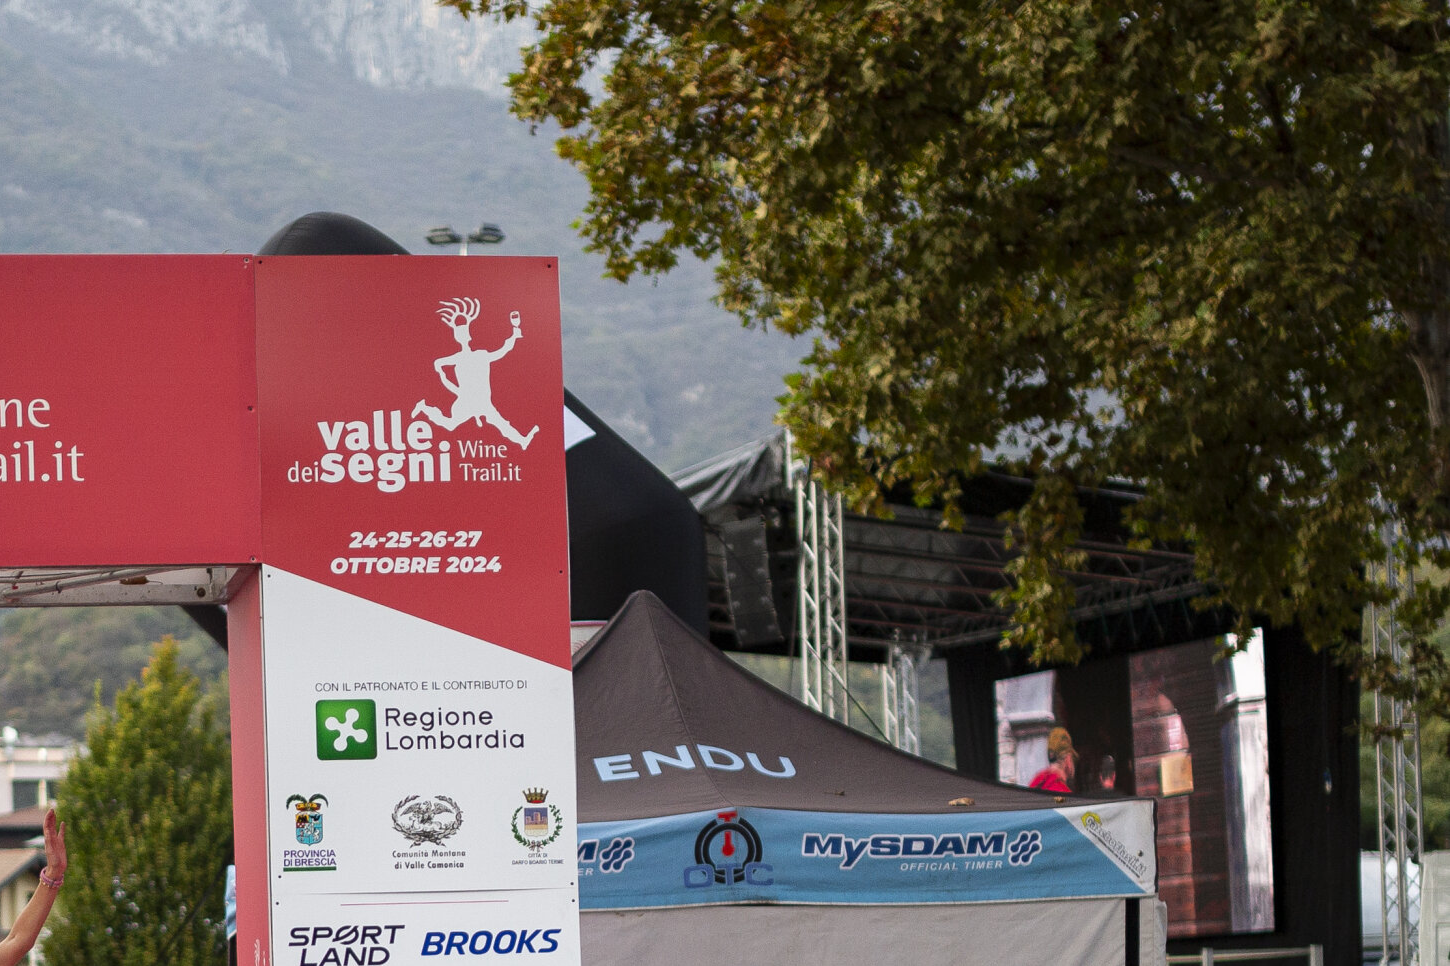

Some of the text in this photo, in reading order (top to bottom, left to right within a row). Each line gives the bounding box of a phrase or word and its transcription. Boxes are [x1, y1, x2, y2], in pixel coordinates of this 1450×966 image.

[317, 409, 433, 450] valle
[456, 440, 507, 458] Wine
[459, 462, 521, 482] Trail.it
[349, 531, 482, 549] 24-25-26-27
[330, 556, 501, 575] OTTOBRE 2024
[315, 680, 527, 692] CON IL PATRONATO E IL CONTRIBUTO DI
[385, 707, 493, 731] Regione
[385, 729, 525, 750] Lombardia
[594, 743, 797, 783] ENDU
[284, 849, 336, 858] PROVINCIA
[284, 857, 336, 867] DI BRESCIA
[432, 849, 466, 857] Montana
[394, 861, 402, 869] di
[404, 861, 426, 869] Valle
[900, 860, 1003, 872] OFFICIAL TIMER
[421, 929, 561, 956] BROOKS
